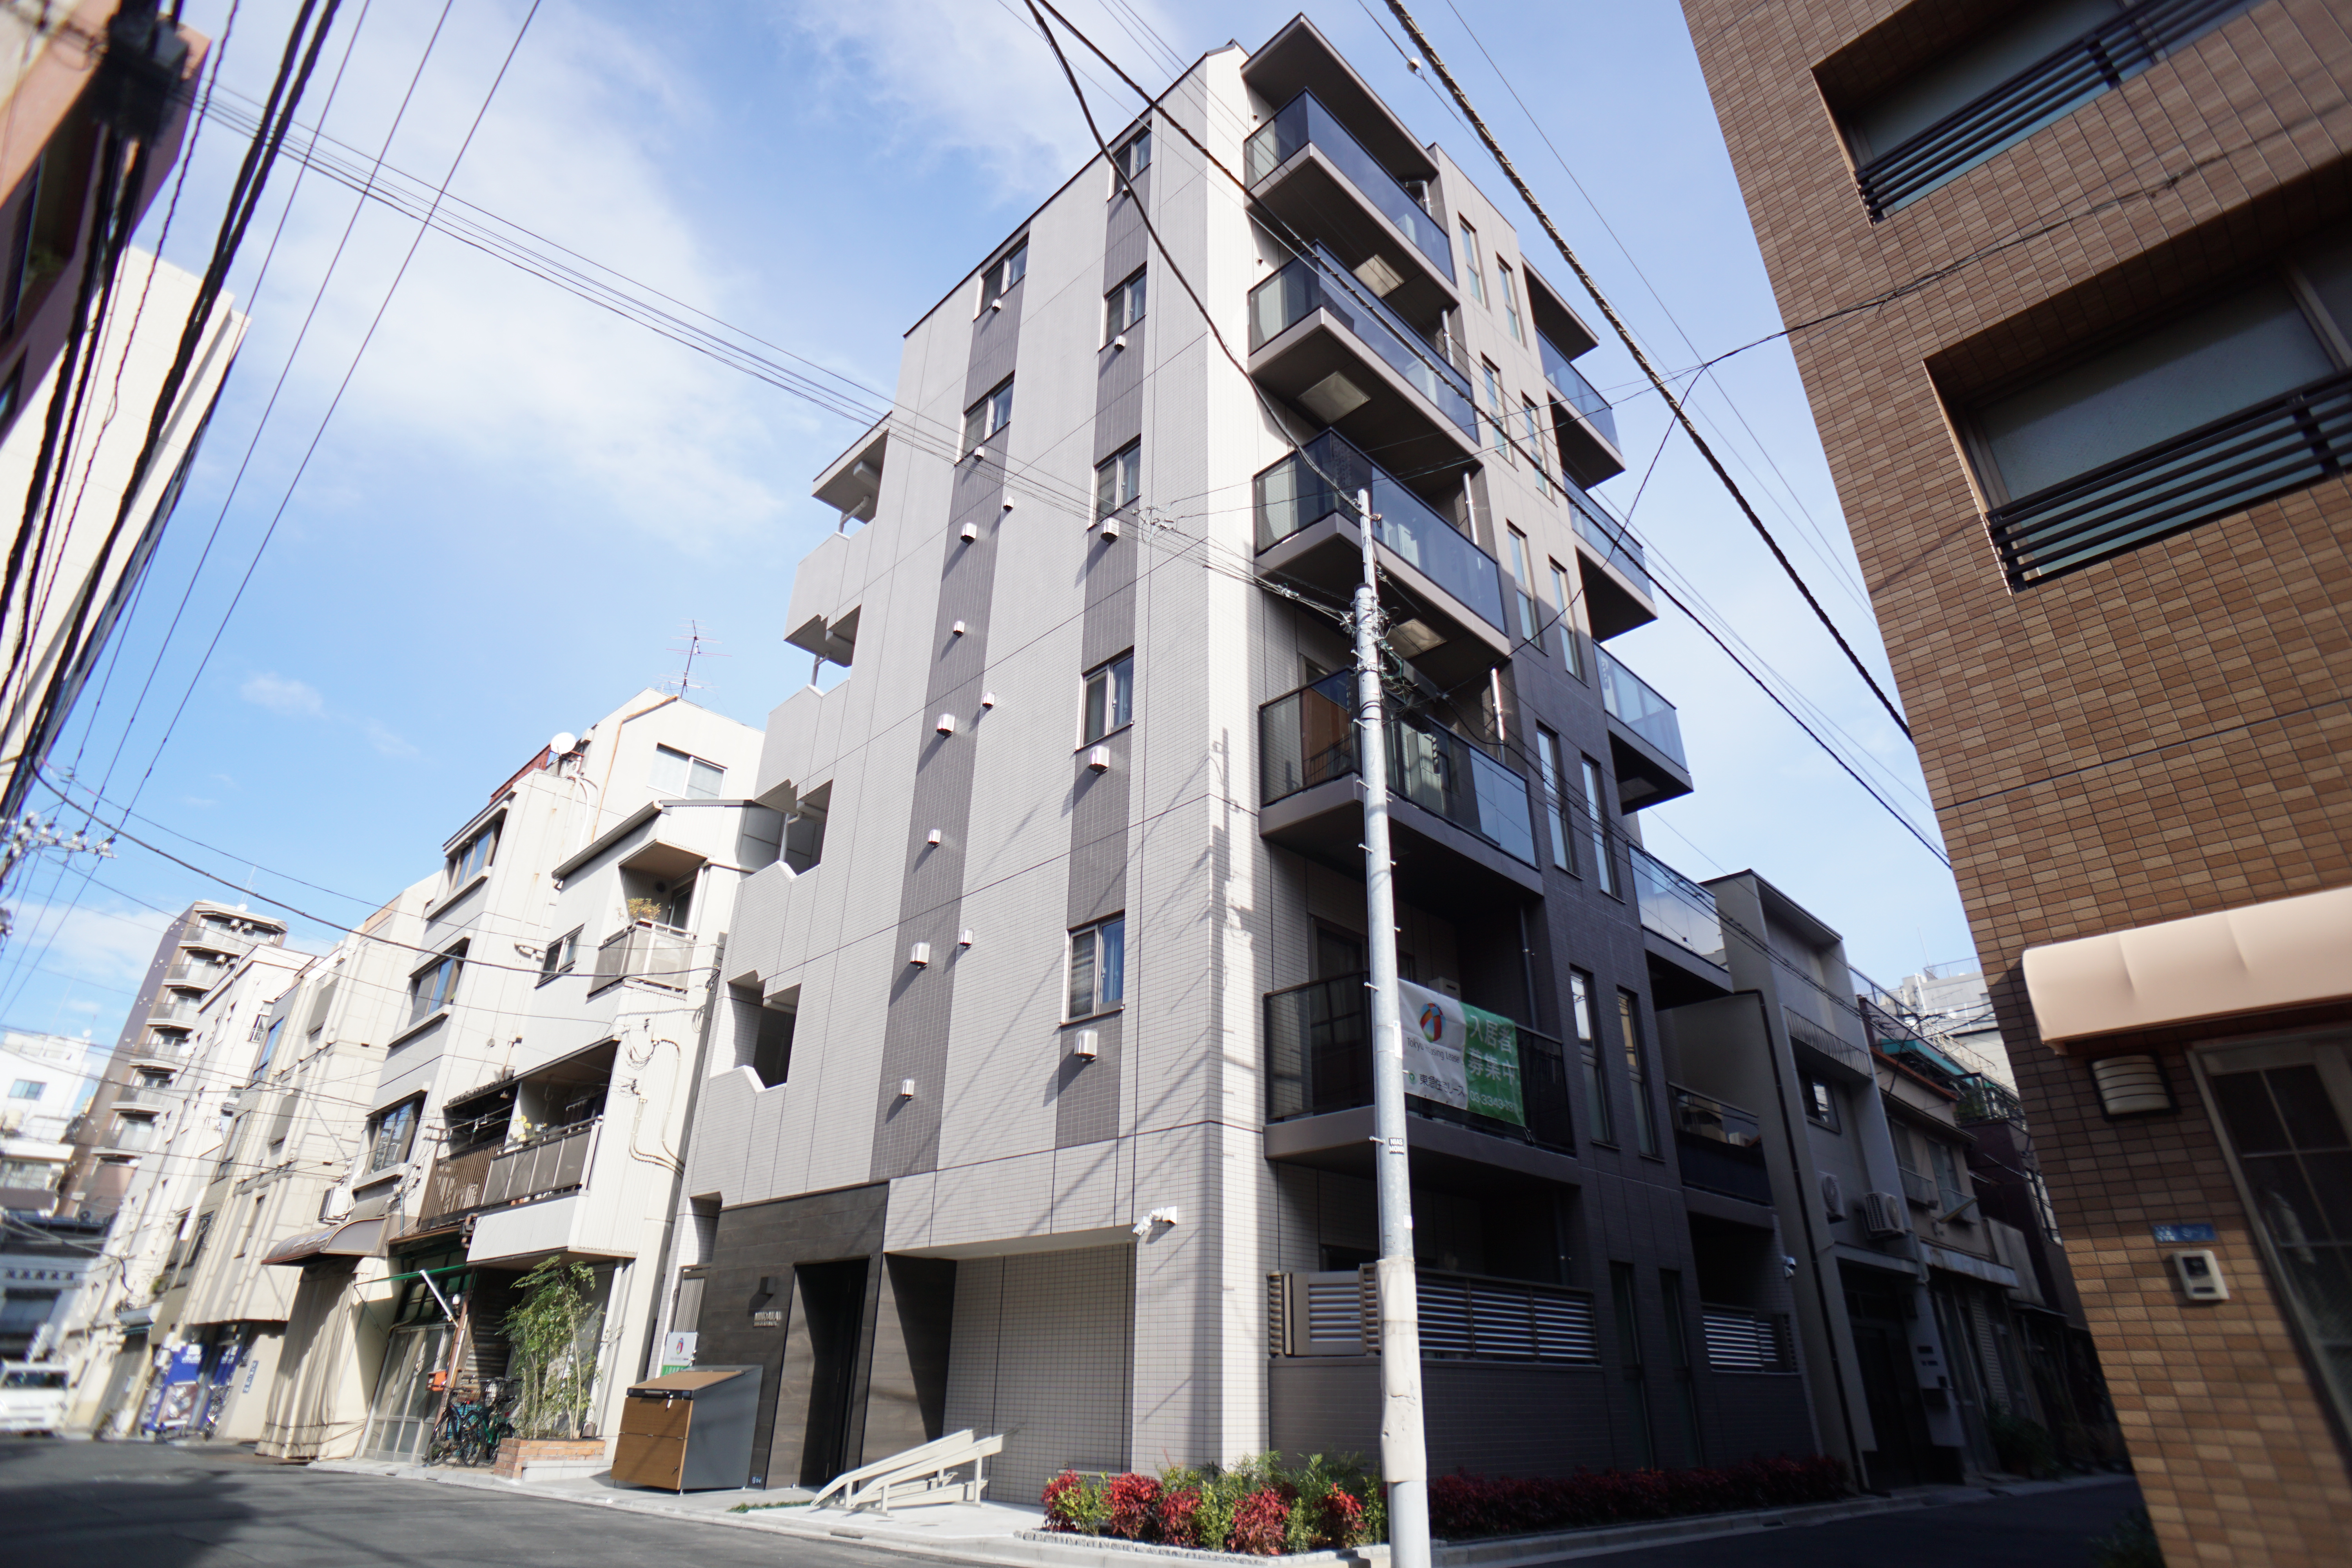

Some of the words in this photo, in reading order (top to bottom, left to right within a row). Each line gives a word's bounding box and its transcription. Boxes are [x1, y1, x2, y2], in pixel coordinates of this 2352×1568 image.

[1407, 1037, 1424, 1051] Tokyu
[1445, 1051, 1459, 1063] Lease
[1470, 1015, 1512, 1053] 入居者
[1468, 1047, 1515, 1085] 募集中
